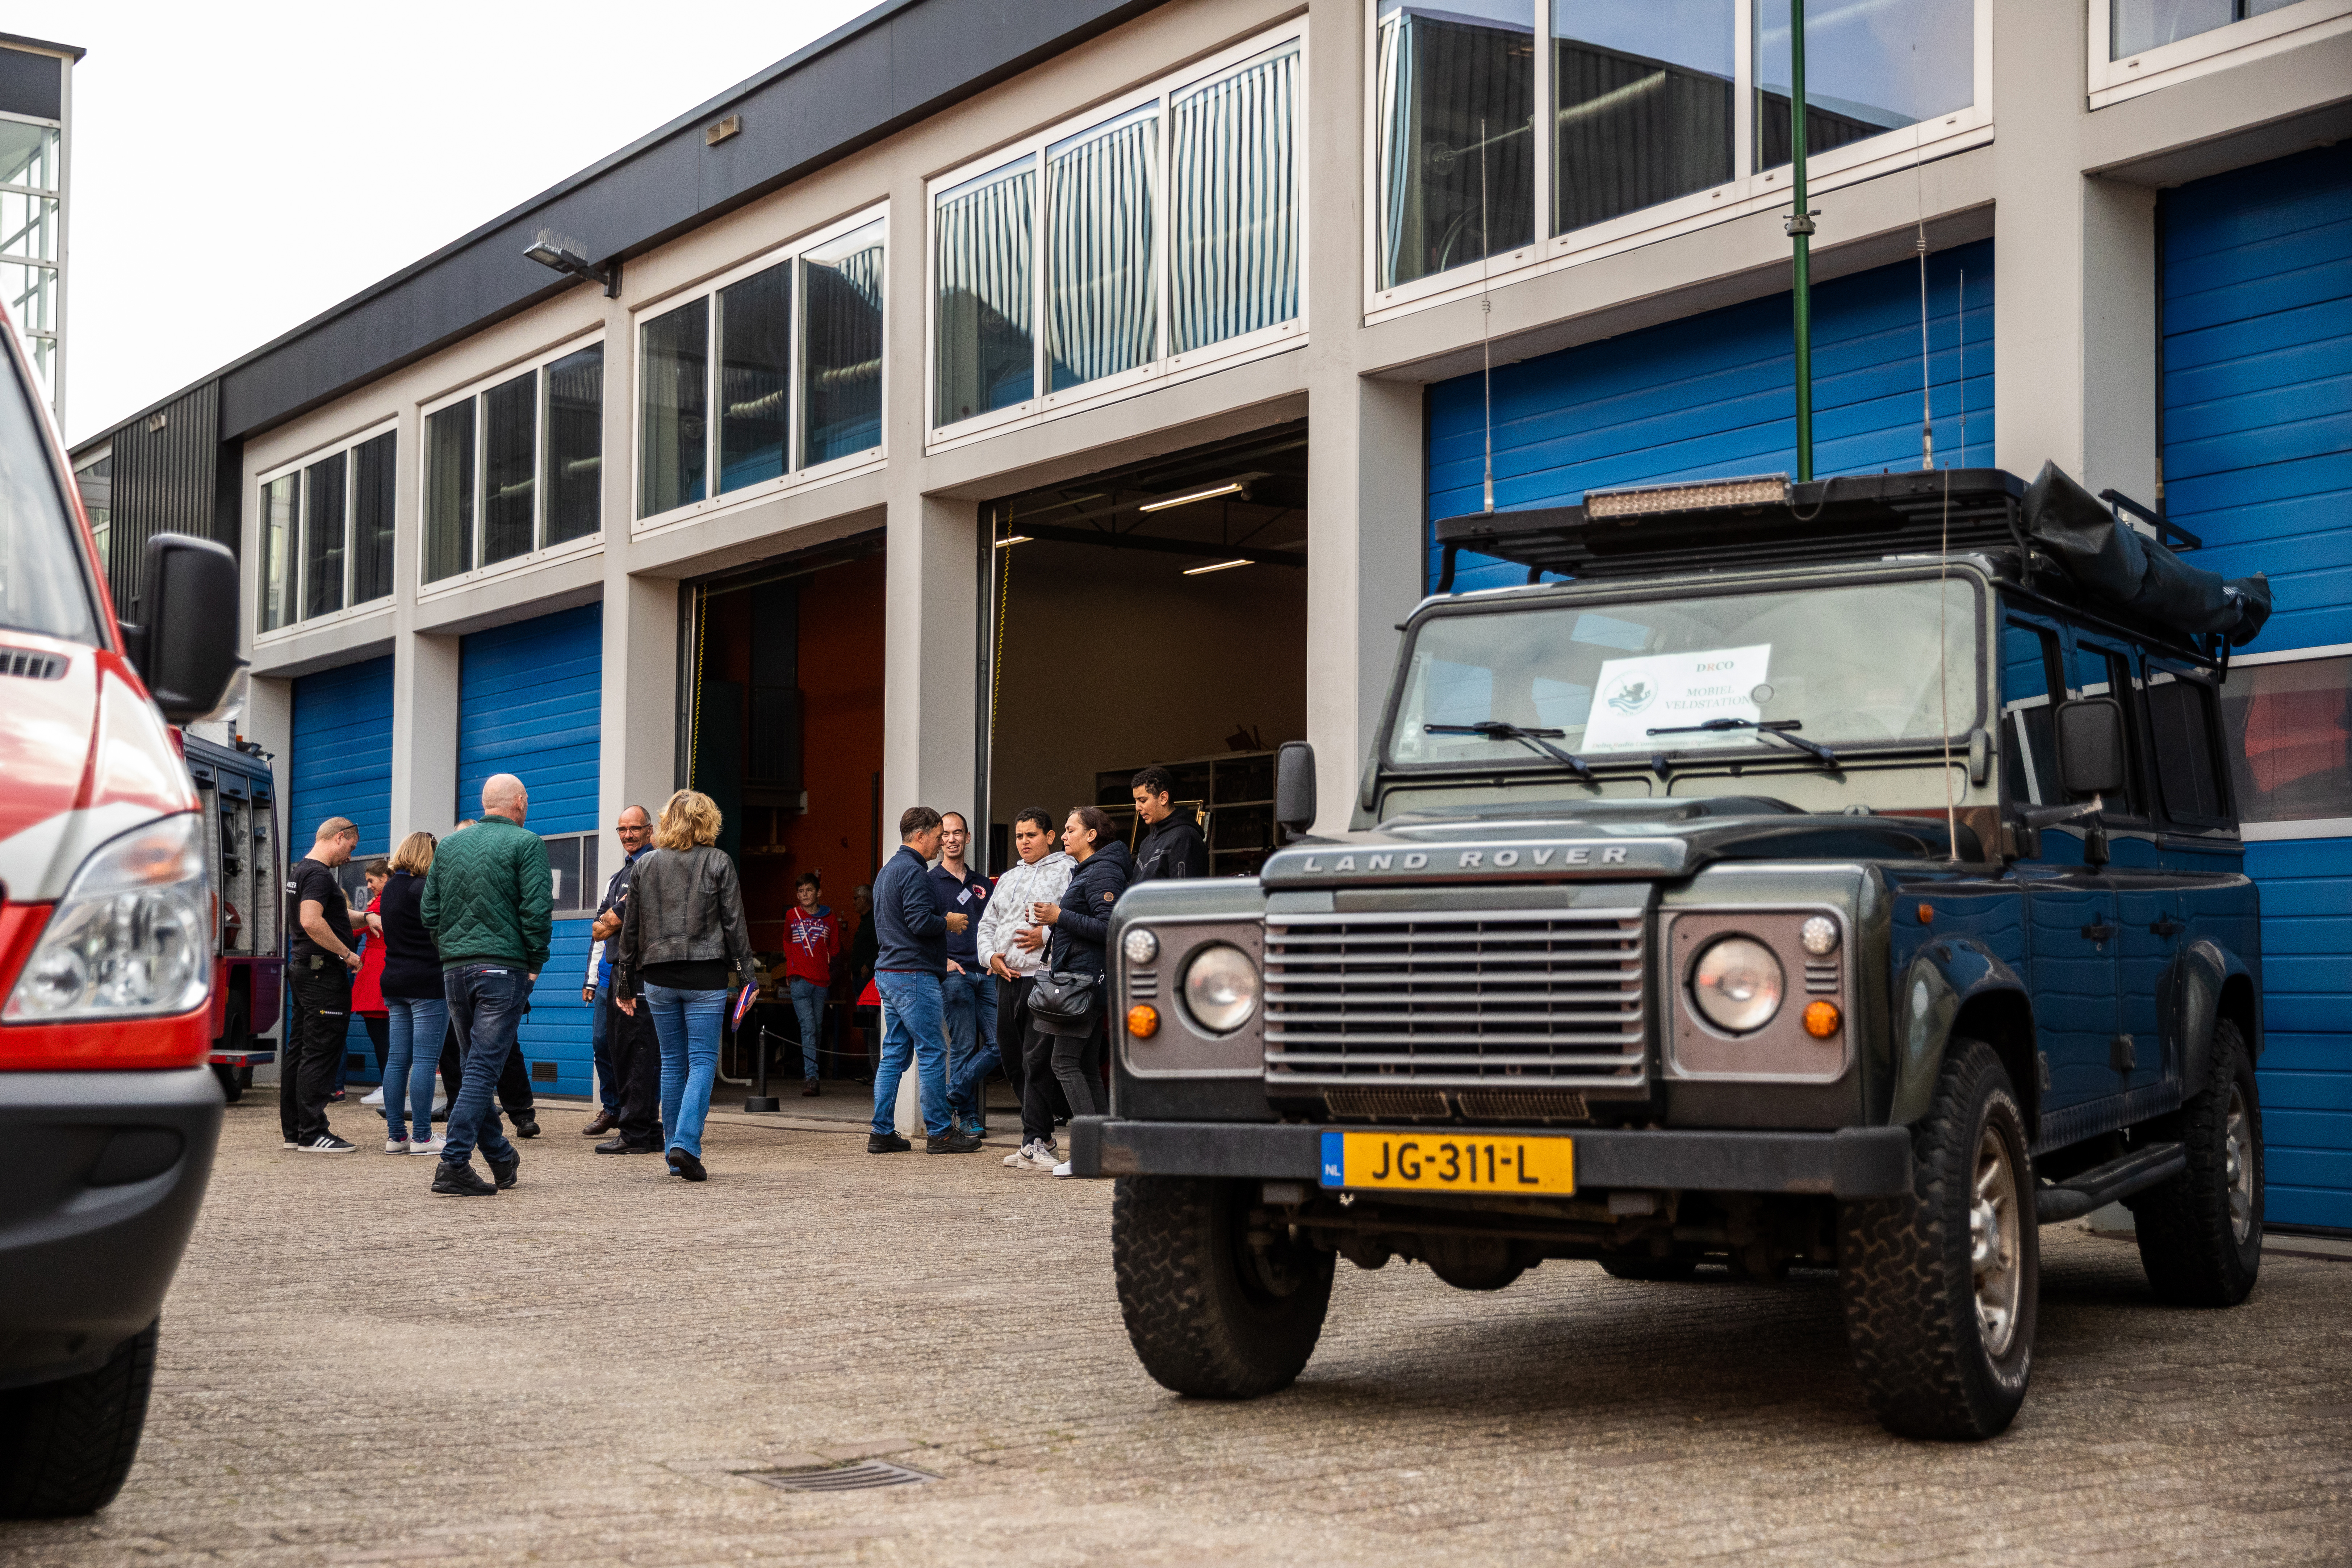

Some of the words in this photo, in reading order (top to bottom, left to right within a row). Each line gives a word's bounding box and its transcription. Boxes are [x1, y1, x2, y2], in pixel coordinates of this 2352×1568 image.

[1696, 661, 1734, 672] DRCO
[1686, 685, 1734, 697] MOBIEL
[1665, 695, 1750, 710] VELDSTATION
[1304, 852, 1428, 872] LAND
[1459, 846, 1628, 868] ROVER
[1372, 1142, 1539, 1184] JG-311-L
[1325, 1164, 1340, 1176] NL
